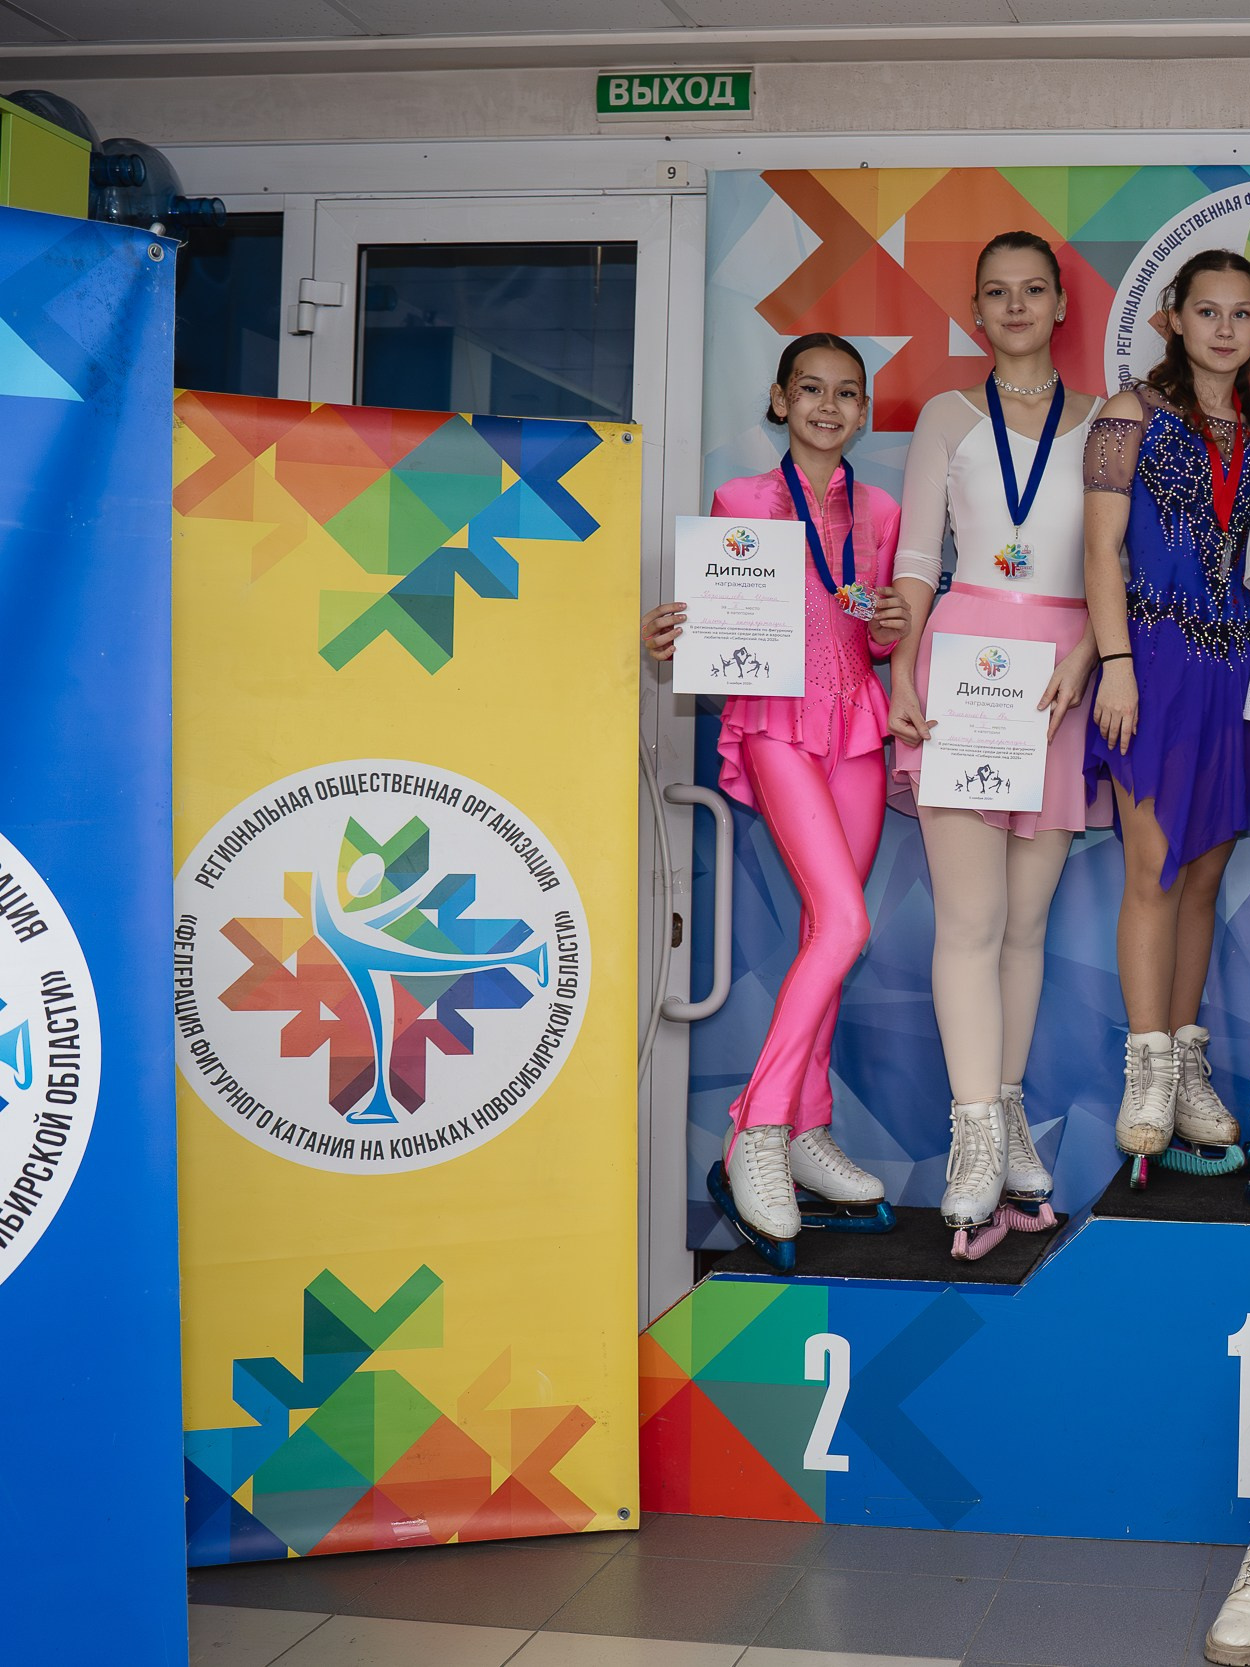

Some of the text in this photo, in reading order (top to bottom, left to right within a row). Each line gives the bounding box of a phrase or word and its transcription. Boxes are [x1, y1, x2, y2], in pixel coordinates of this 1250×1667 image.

[609, 76, 735, 106] ВЫХОД
[667, 166, 676, 179] 9
[1116, 259, 1159, 356] РЕГИОНАЛЬНАЯ
[1152, 195, 1242, 262] ОБЩЕСТВЕННАЯ
[705, 563, 775, 578] Диплом
[715, 581, 766, 589] награждается
[956, 682, 1023, 698] Диплом
[965, 700, 1014, 709] награждается
[195, 772, 560, 893] РЕГИОНАЛЬНАЯ ОБЩЕСТВЕННАЯ ОРГАНИЗАЦИЯ
[41, 970, 80, 1105] ОБЛАСТИ»
[190, 1039, 272, 1130] ФИГУРНОГО
[271, 1119, 354, 1160] КАТАНИЯ
[360, 1140, 385, 1160] НА
[390, 1120, 476, 1160] КОНЬКАХ
[472, 1006, 574, 1130] НОВОСИБИРСКОЙ
[554, 910, 578, 1000] ОБЛАСТИ»
[803, 1333, 851, 1472] 2
